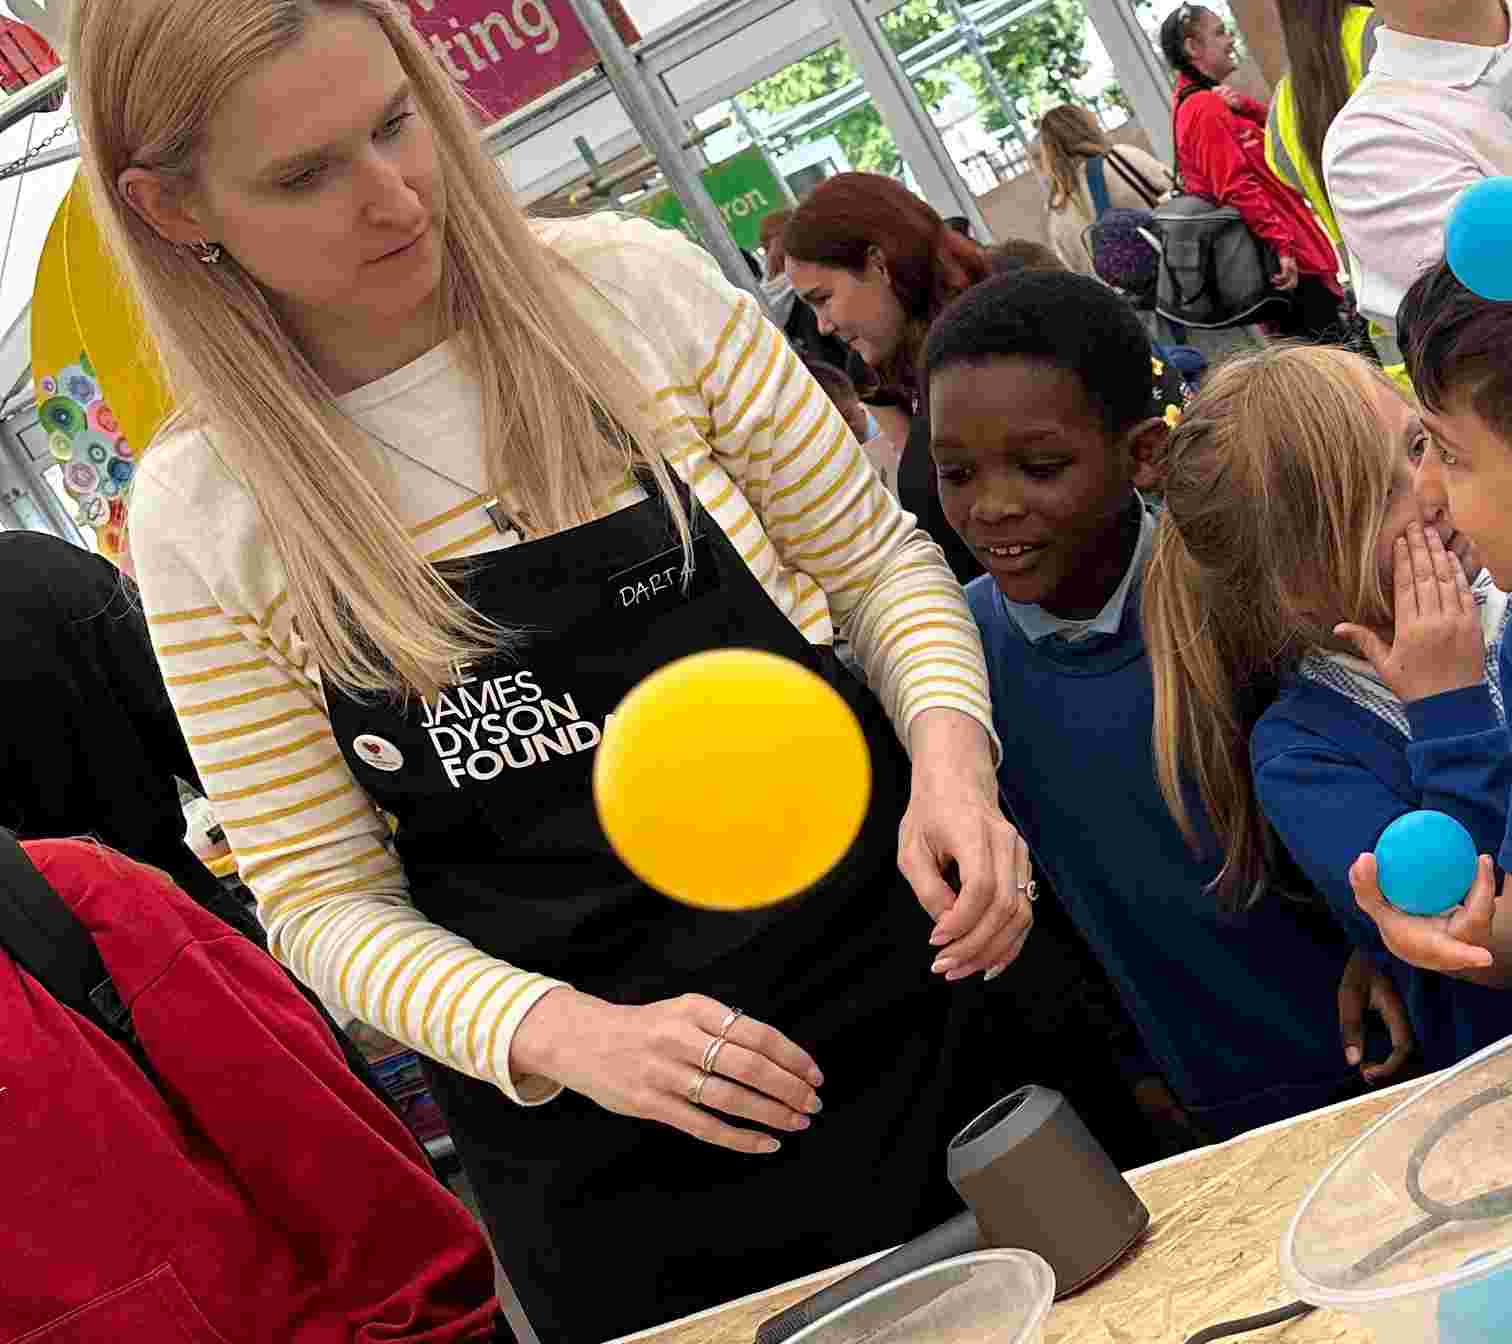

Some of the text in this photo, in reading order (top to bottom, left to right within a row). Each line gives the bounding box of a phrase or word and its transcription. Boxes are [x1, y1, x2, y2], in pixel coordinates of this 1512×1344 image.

[421, 670, 543, 728] JAMES
[428, 692, 581, 758] DYSON
[441, 714, 616, 788] FOUND
